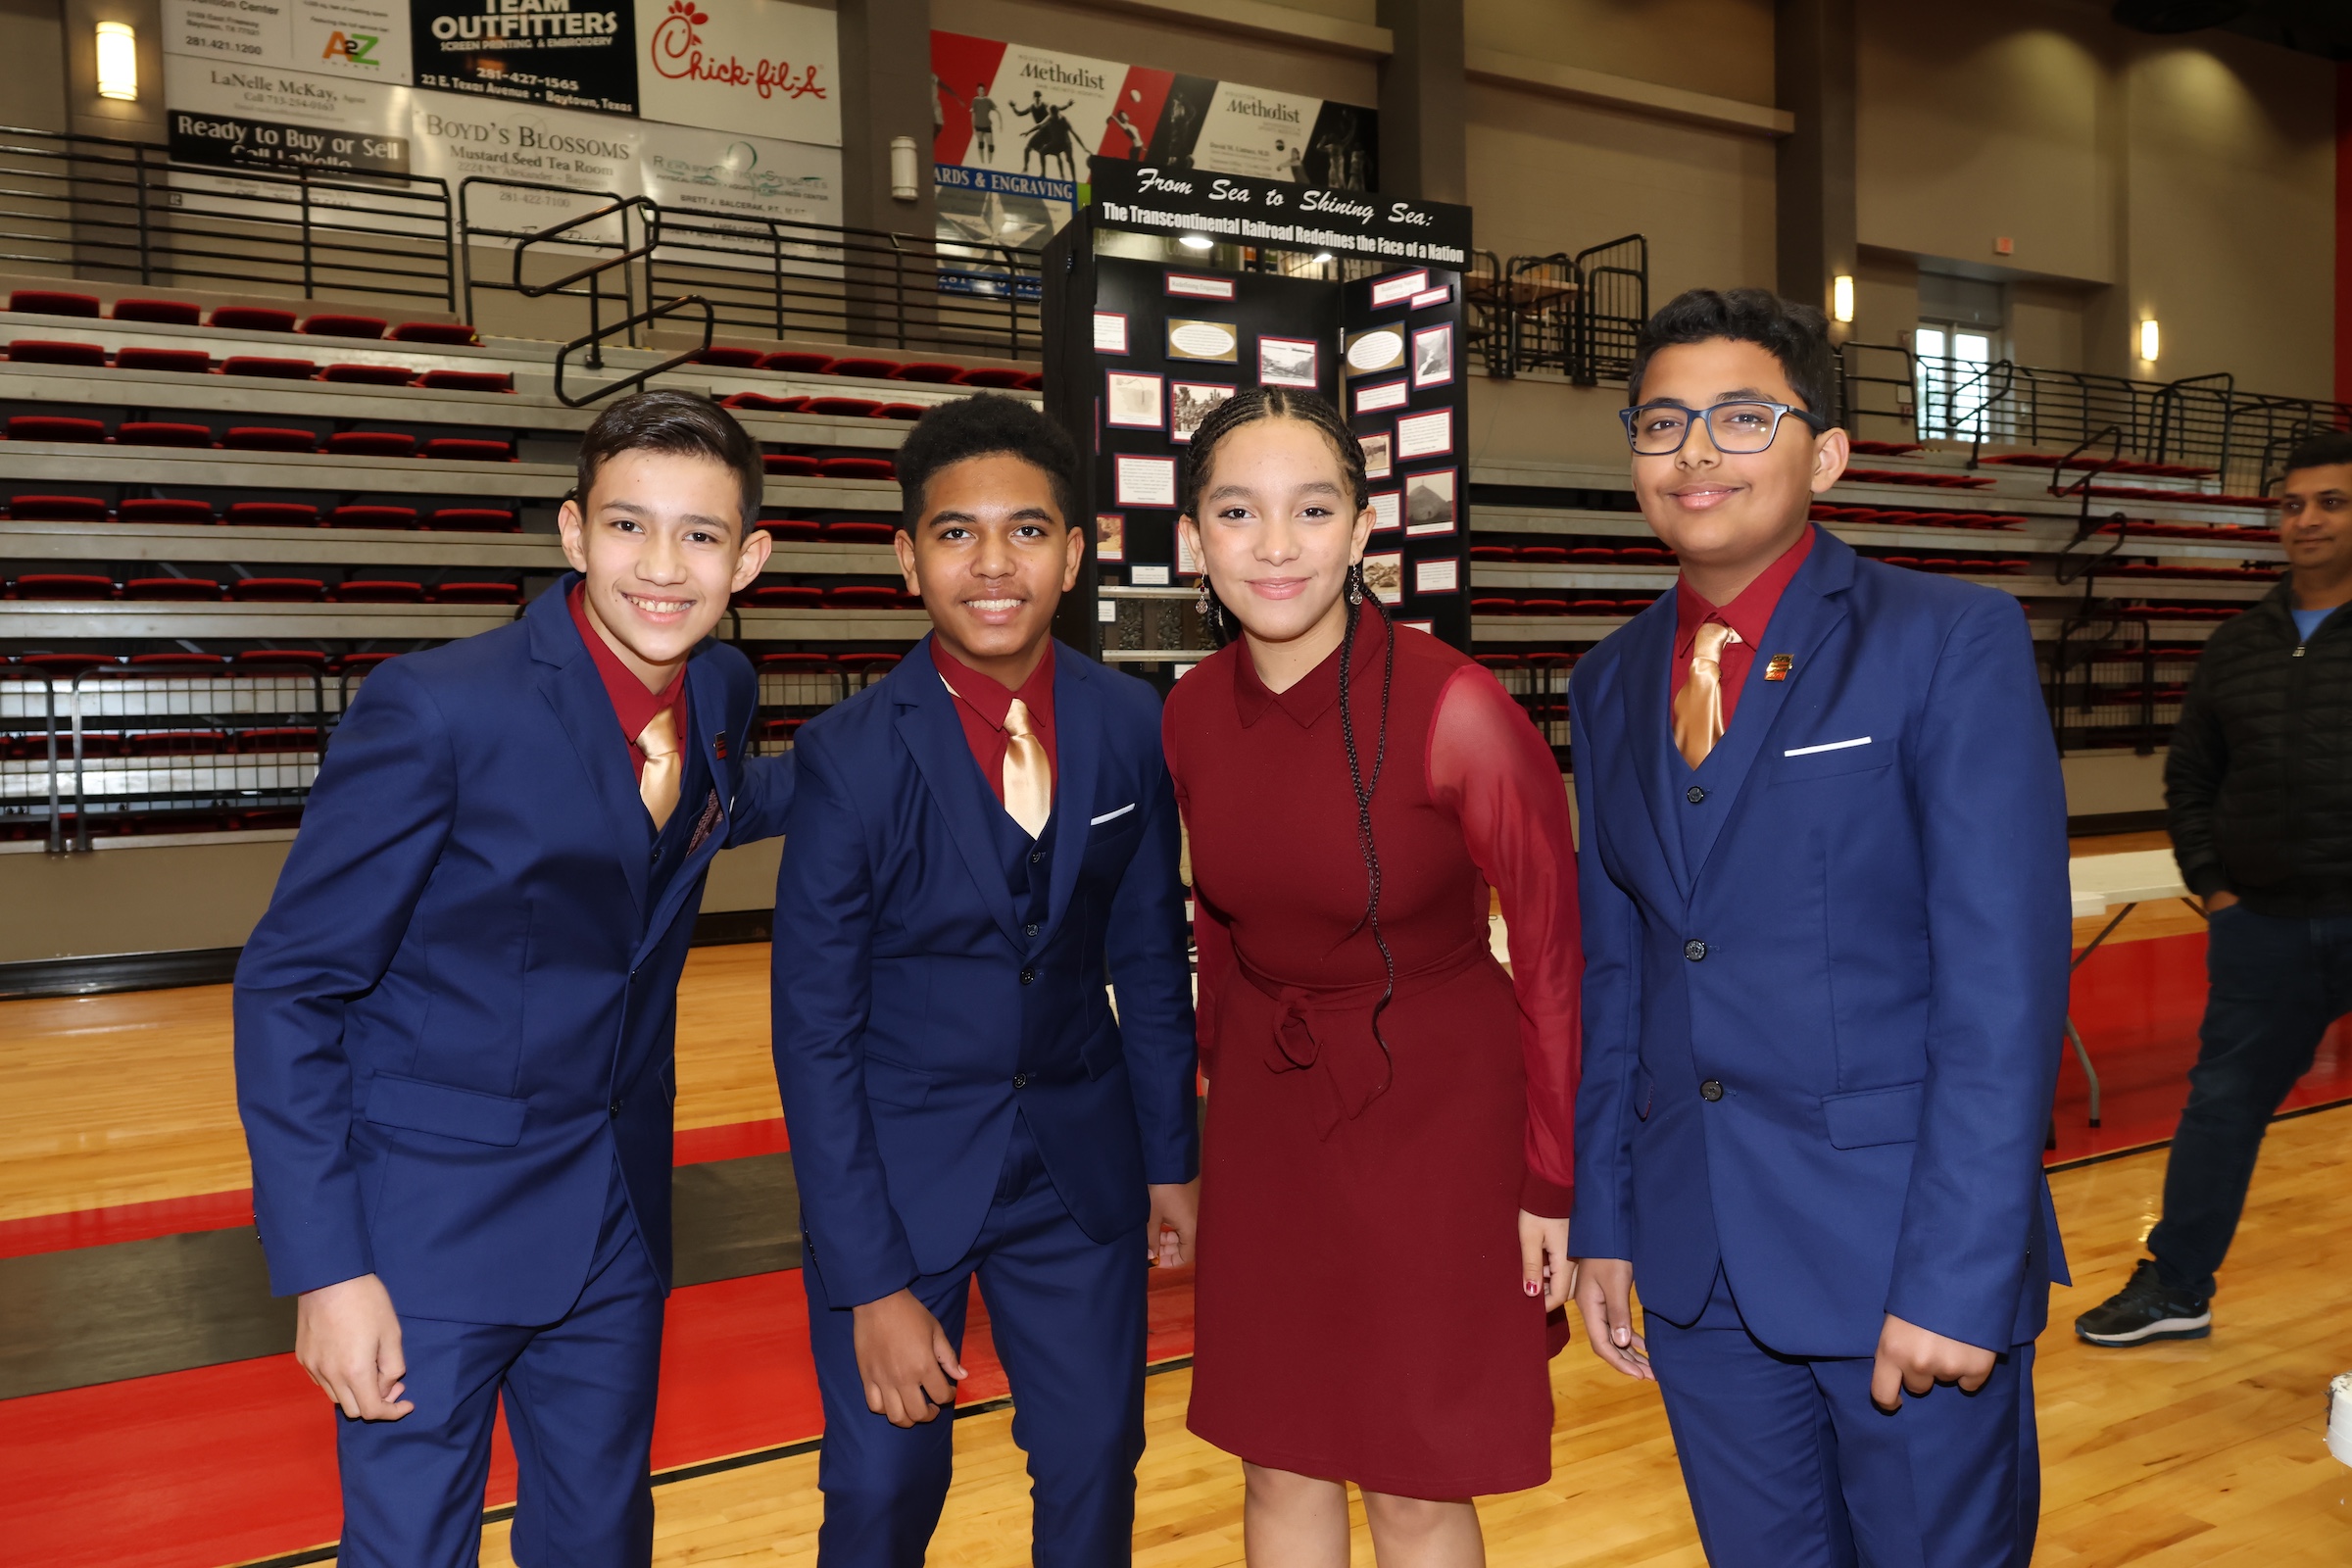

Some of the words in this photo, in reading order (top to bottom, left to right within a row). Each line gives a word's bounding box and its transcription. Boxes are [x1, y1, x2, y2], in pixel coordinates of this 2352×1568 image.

[486, 0, 569, 14] TEAM
[431, 11, 618, 40] OUTFITTERS
[441, 41, 480, 52] SCREEN
[482, 38, 533, 50] PRINTING
[547, 36, 613, 48] EMBROIDERY
[652, 16, 827, 99] Chick-fil-A
[211, 71, 272, 91] LaNelle
[278, 79, 338, 101] McKay,
[476, 67, 579, 92] 281-427-1565
[1019, 63, 1104, 90] Methodist
[421, 74, 437, 85] 22
[438, 75, 450, 87] E.
[452, 77, 484, 93] Texas
[486, 82, 529, 99] Avenue
[546, 90, 600, 109] Baytown,
[602, 98, 632, 113] Texas
[1226, 99, 1300, 123] Methodist
[177, 116, 247, 143] Ready
[255, 126, 278, 145] to
[286, 129, 325, 153] Buy
[332, 137, 355, 154] or
[363, 138, 399, 160] Sell
[518, 125, 630, 160] BLOSSOMS
[450, 146, 509, 164] Mustard
[512, 152, 542, 168] Seed
[546, 156, 571, 172] Tea
[574, 160, 613, 176] Room
[680, 195, 707, 205] BRETT
[975, 172, 986, 188] &
[992, 174, 1073, 199] ENGRAVING
[1137, 168, 1194, 194] From
[1208, 179, 1250, 203] Sea
[1265, 189, 1284, 207] to
[1299, 190, 1374, 224] Shining
[1388, 203, 1434, 226] Sea:
[1102, 202, 1128, 222] The
[1129, 205, 1241, 235] Transcontinental
[1242, 219, 1294, 241] Railroad
[1296, 225, 1355, 250] Redefines
[1356, 234, 1376, 253] the
[1378, 237, 1403, 256] Face
[1405, 241, 1419, 258] of
[1419, 245, 1426, 258] a
[1428, 243, 1464, 264] Nation
